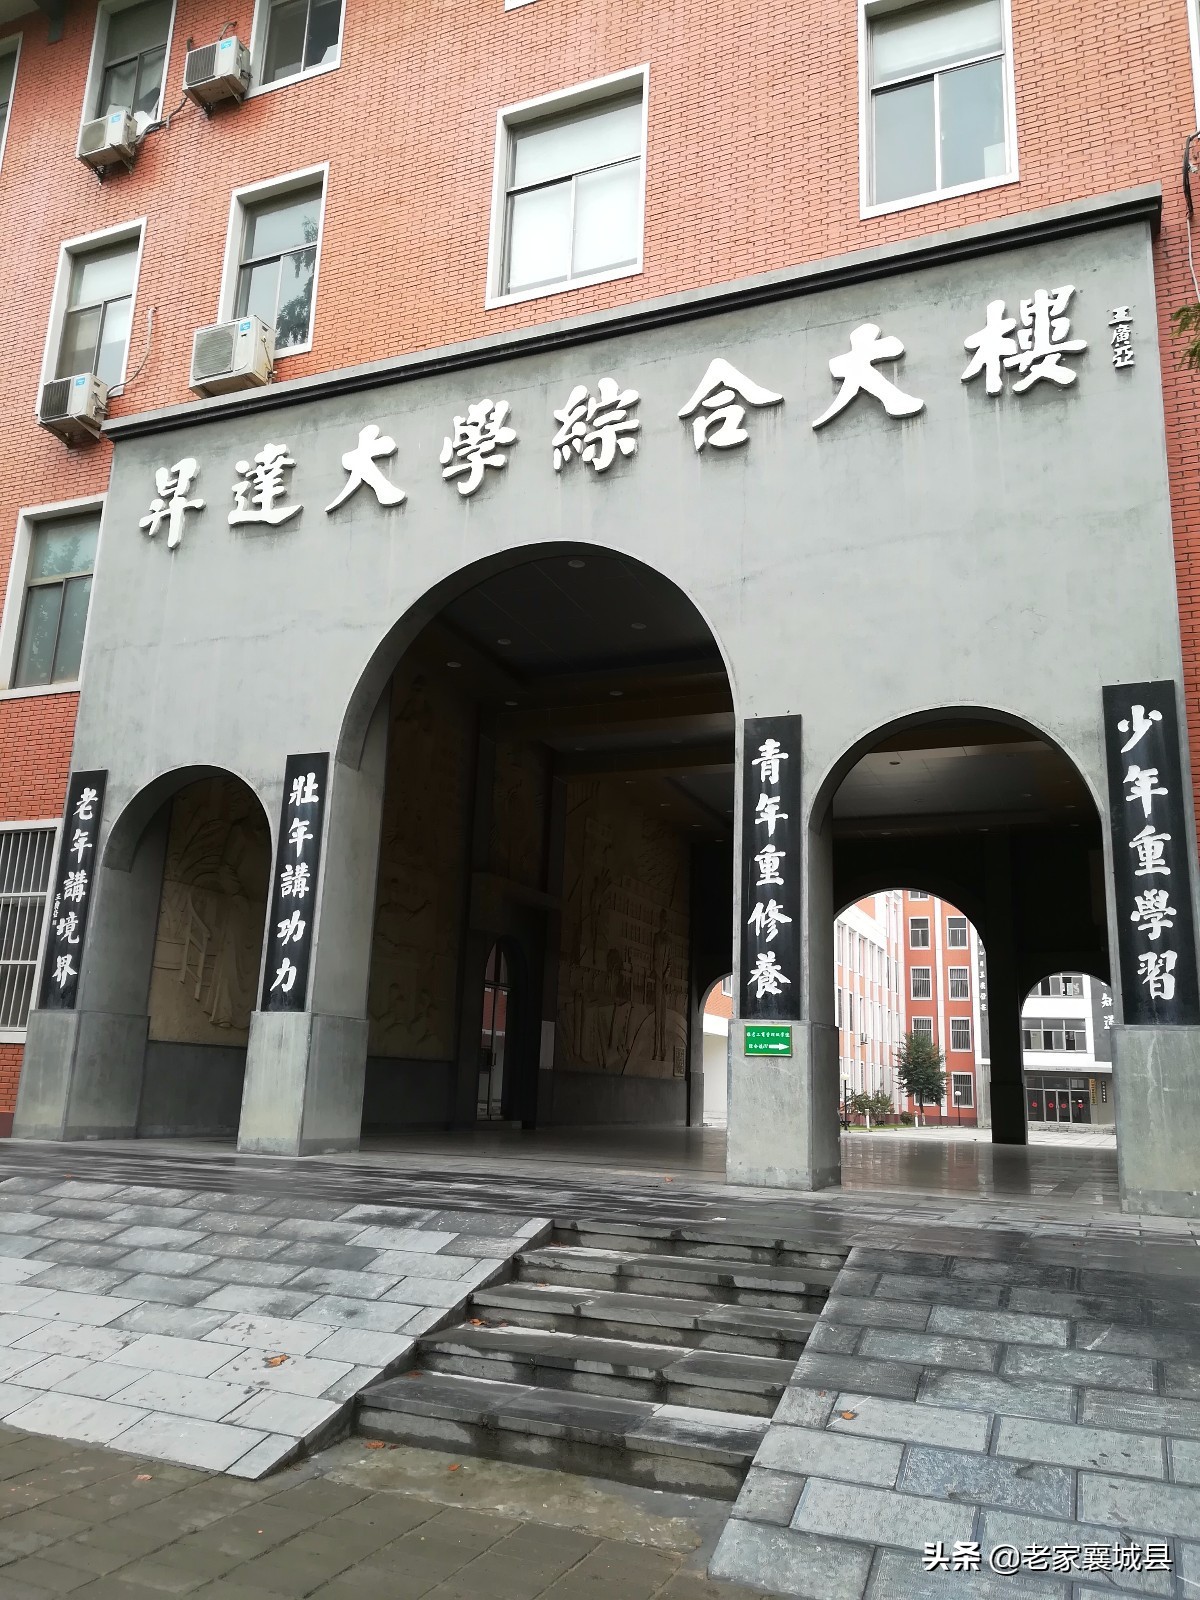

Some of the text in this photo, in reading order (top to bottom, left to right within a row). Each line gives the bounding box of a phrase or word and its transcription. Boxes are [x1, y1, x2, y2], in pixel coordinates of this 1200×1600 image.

[138, 284, 1088, 549] 昇達大學綜合大樓
[1108, 305, 1135, 368] 王廣亞
[52, 787, 98, 989] 老年講境界
[270, 772, 319, 993] 壯年講功力
[747, 738, 792, 998] 青年重修養
[1117, 704, 1178, 1000] 少年重學習
